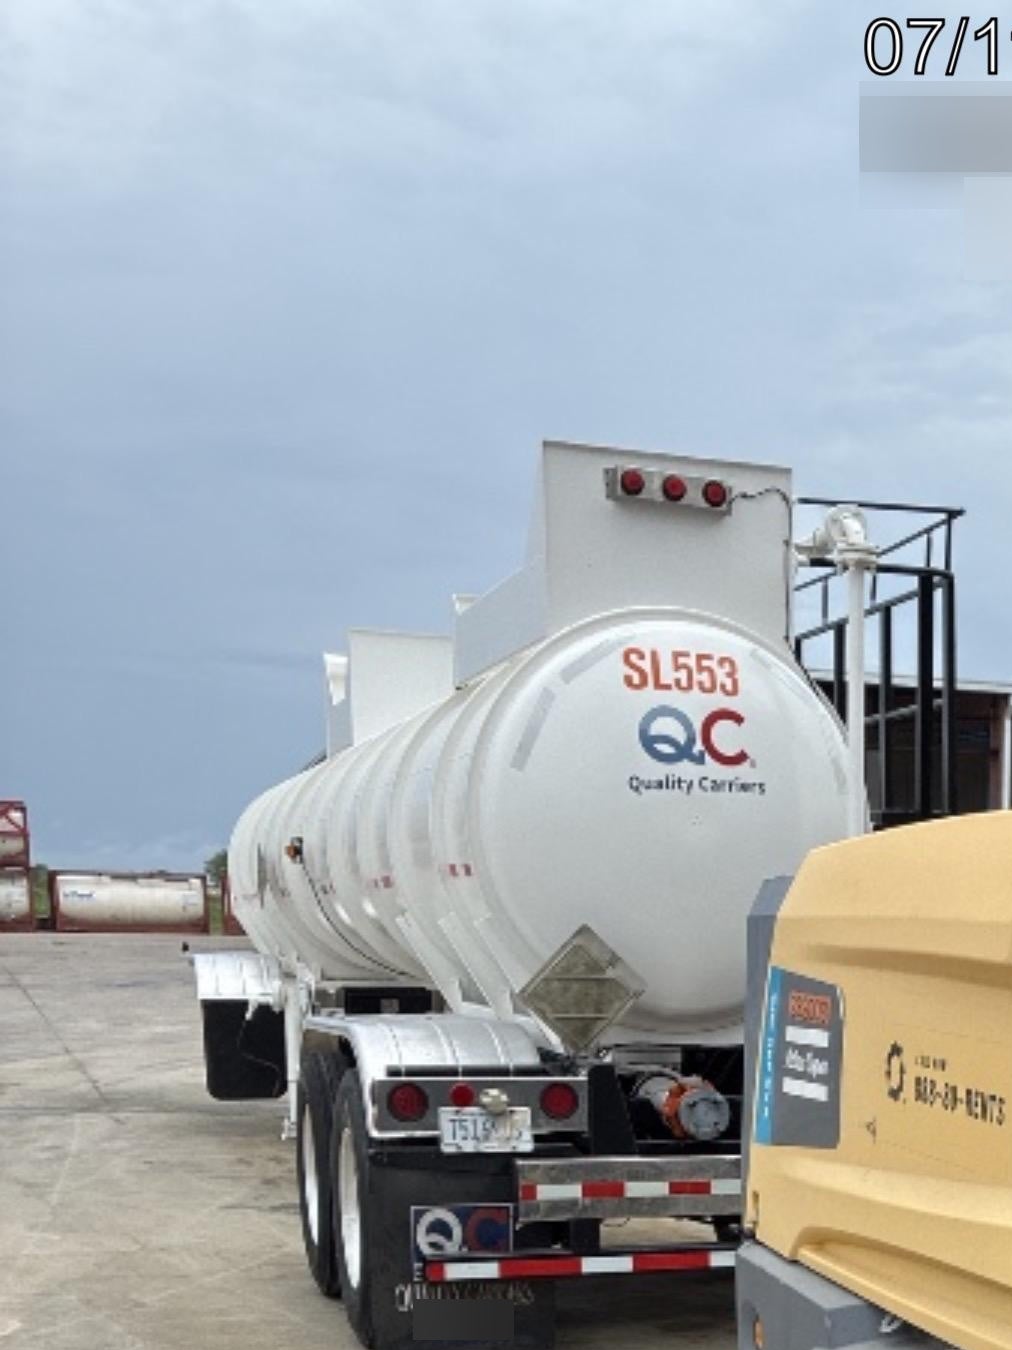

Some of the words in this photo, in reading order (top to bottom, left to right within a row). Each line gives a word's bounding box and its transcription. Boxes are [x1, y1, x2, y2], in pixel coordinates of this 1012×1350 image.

[622, 647, 740, 697] SL553
[637, 704, 751, 767] QC
[628, 773, 694, 796] Quality
[698, 775, 766, 796] Carriers
